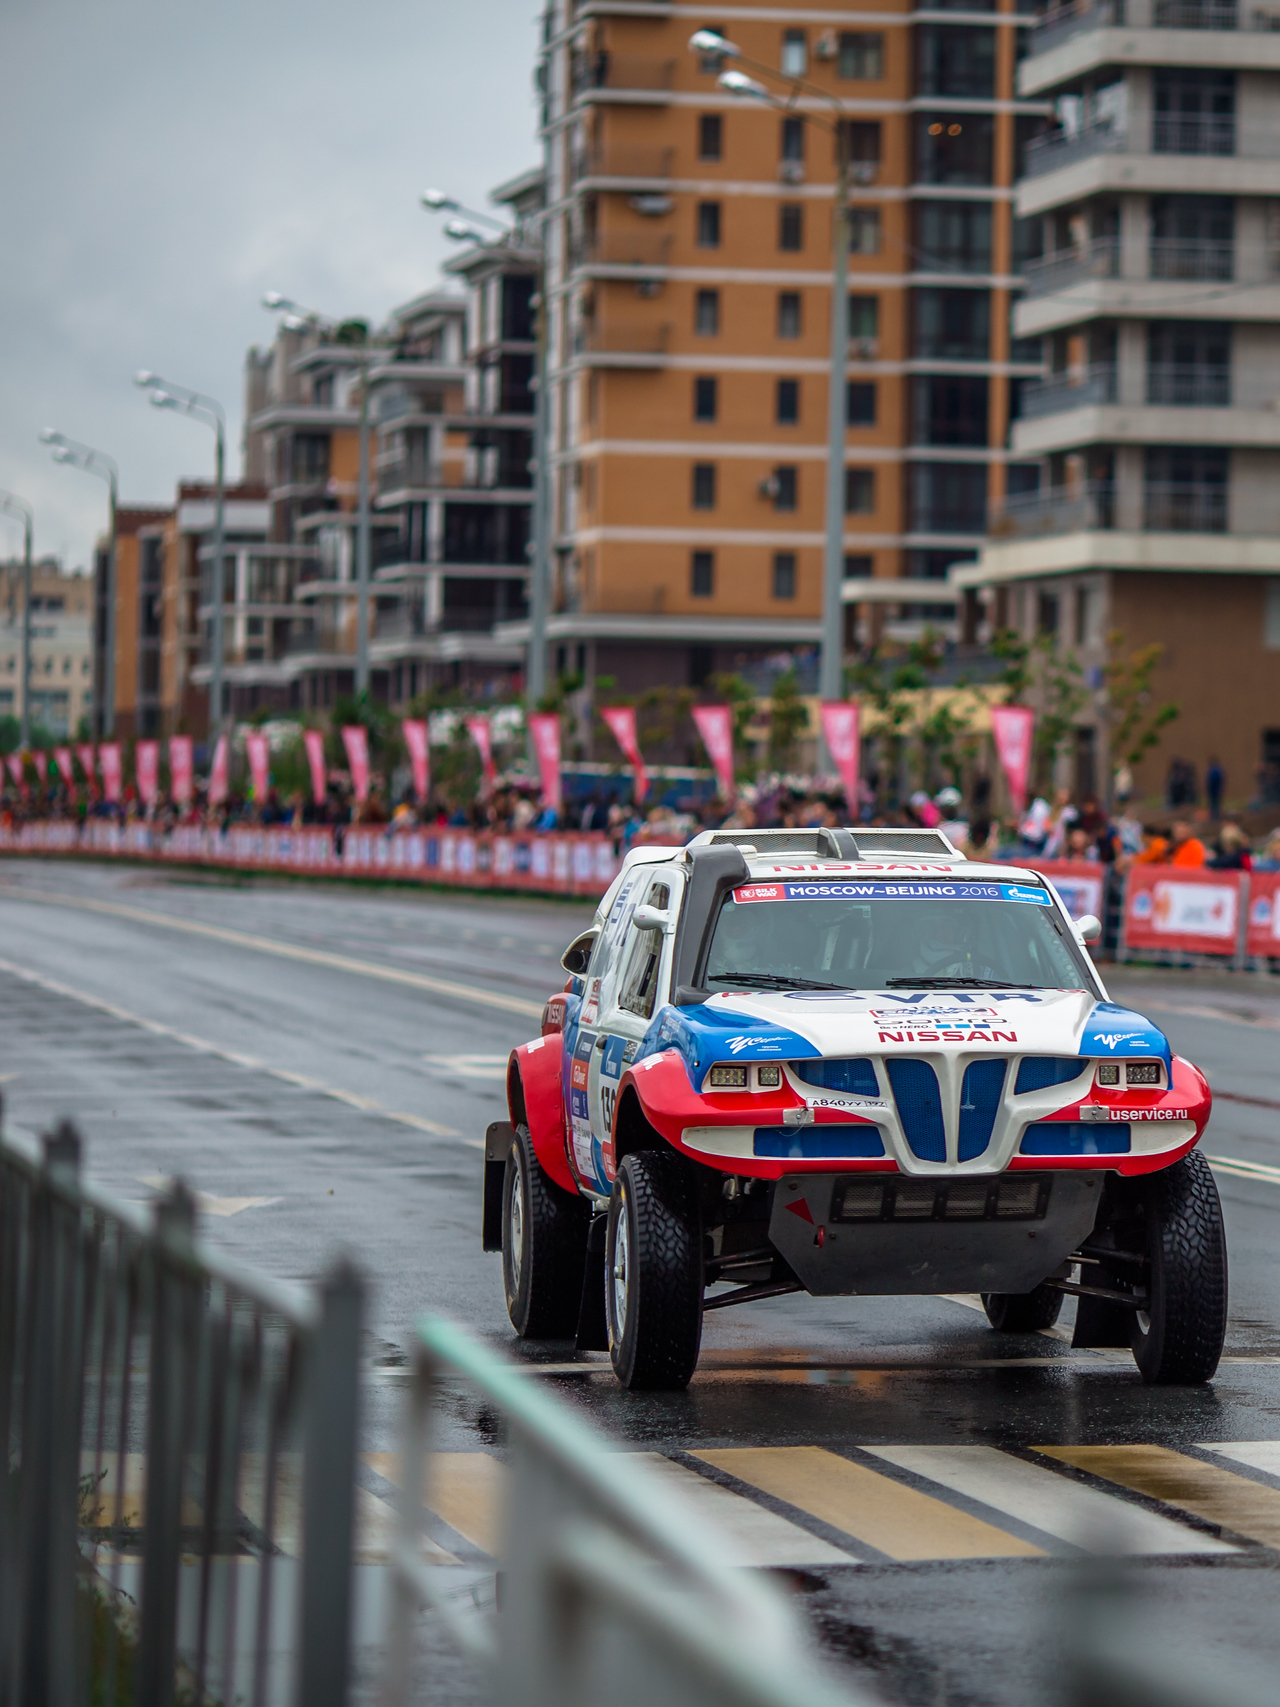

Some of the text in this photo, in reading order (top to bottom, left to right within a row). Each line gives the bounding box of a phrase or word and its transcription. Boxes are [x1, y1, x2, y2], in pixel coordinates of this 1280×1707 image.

[773, 863, 952, 872] NISSAN
[959, 886, 998, 896] 2016
[878, 1031, 1018, 1042] NISSAN
[1111, 1107, 1187, 1120] uservice.ru
